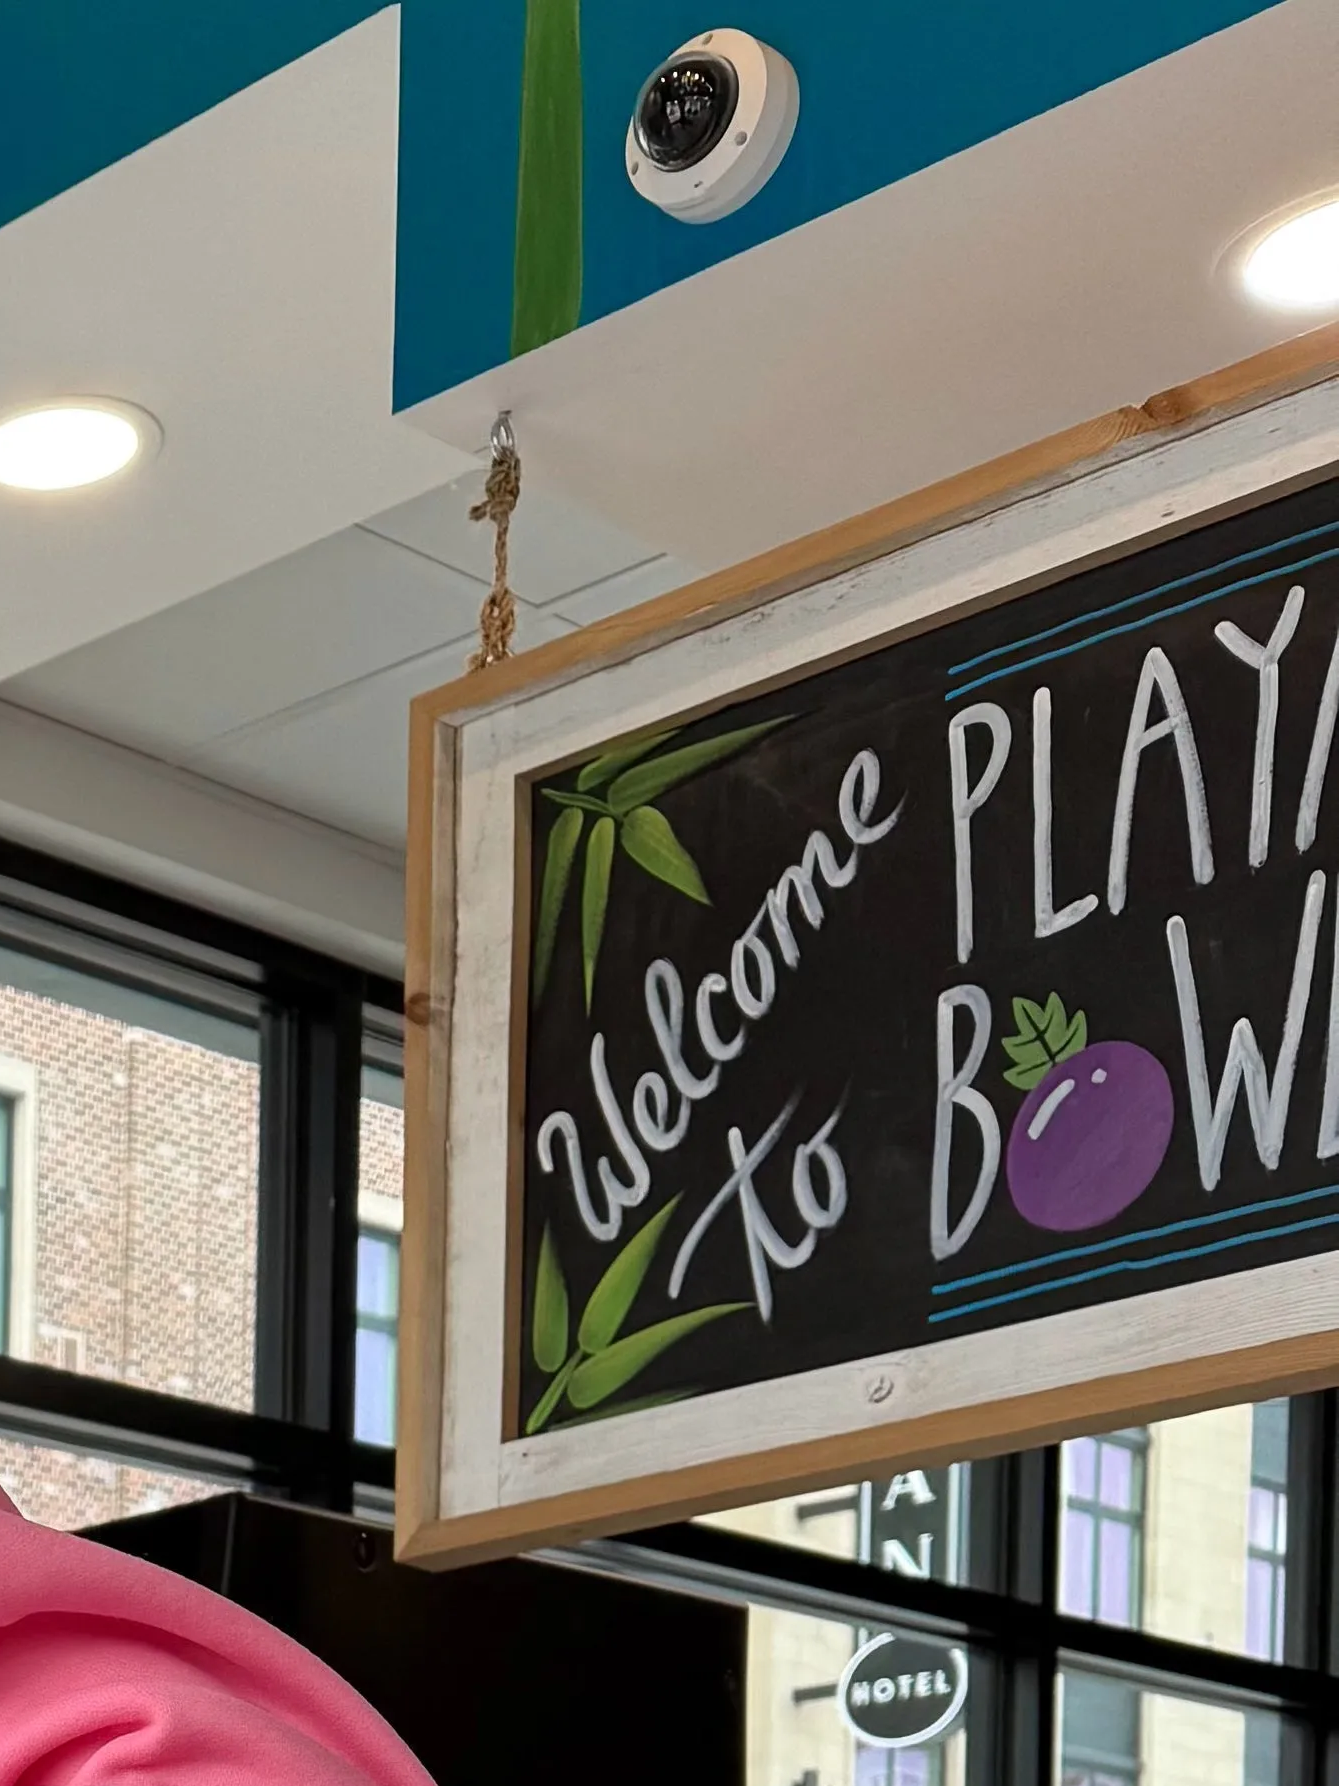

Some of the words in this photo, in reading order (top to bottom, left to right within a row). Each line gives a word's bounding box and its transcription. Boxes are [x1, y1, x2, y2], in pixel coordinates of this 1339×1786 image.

[537, 747, 907, 1242] Welcome
[669, 1076, 852, 1325] to
[851, 1669, 951, 1705] HOTEL
